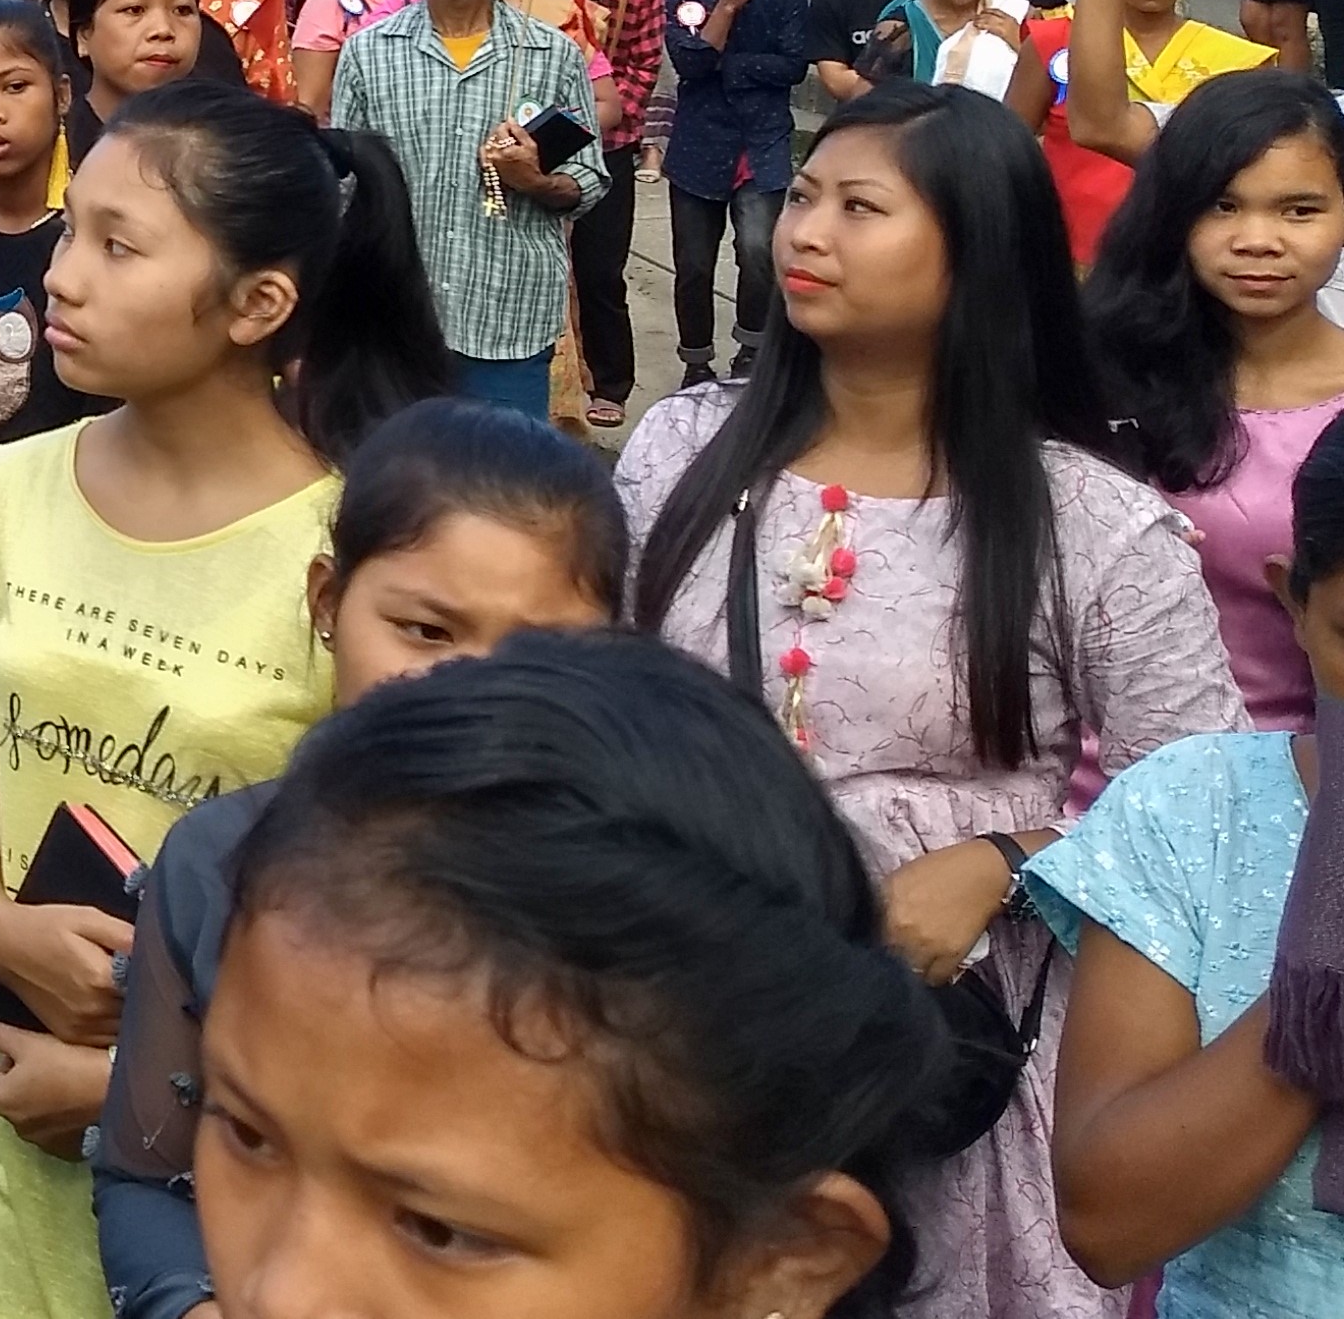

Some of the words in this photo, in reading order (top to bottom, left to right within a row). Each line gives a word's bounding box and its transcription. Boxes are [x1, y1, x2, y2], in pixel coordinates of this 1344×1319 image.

[6, 581, 66, 611] THERE
[75, 602, 116, 624] ARE
[127, 618, 202, 656] SEVEN
[216, 649, 286, 681] DAYS
[122, 644, 184, 677] WEEK
